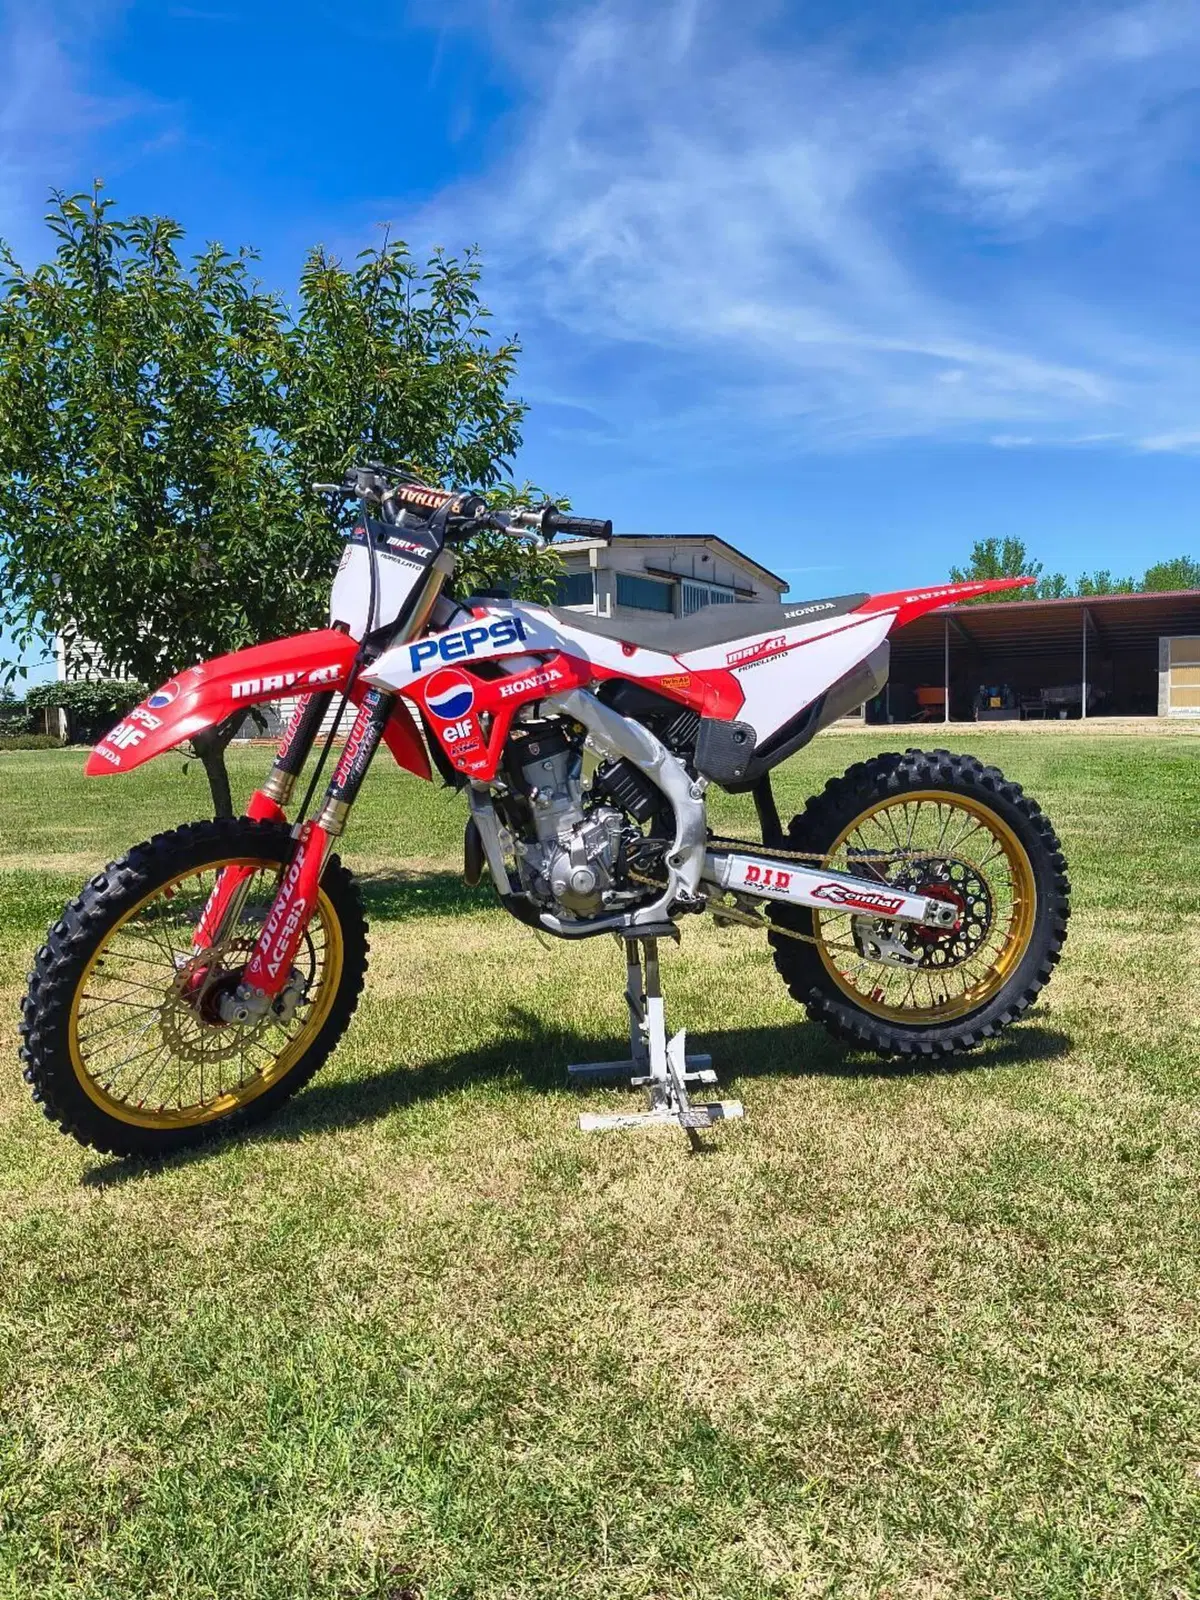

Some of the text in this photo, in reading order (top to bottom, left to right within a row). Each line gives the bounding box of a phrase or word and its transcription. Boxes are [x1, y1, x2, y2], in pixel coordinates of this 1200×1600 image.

[400, 488, 460, 513] RNTHAL
[784, 602, 836, 619] HONDA
[408, 617, 527, 673] PEPSI
[499, 669, 563, 697] HONDA
[443, 719, 473, 743] elf
[260, 845, 305, 954] DUNLOP
